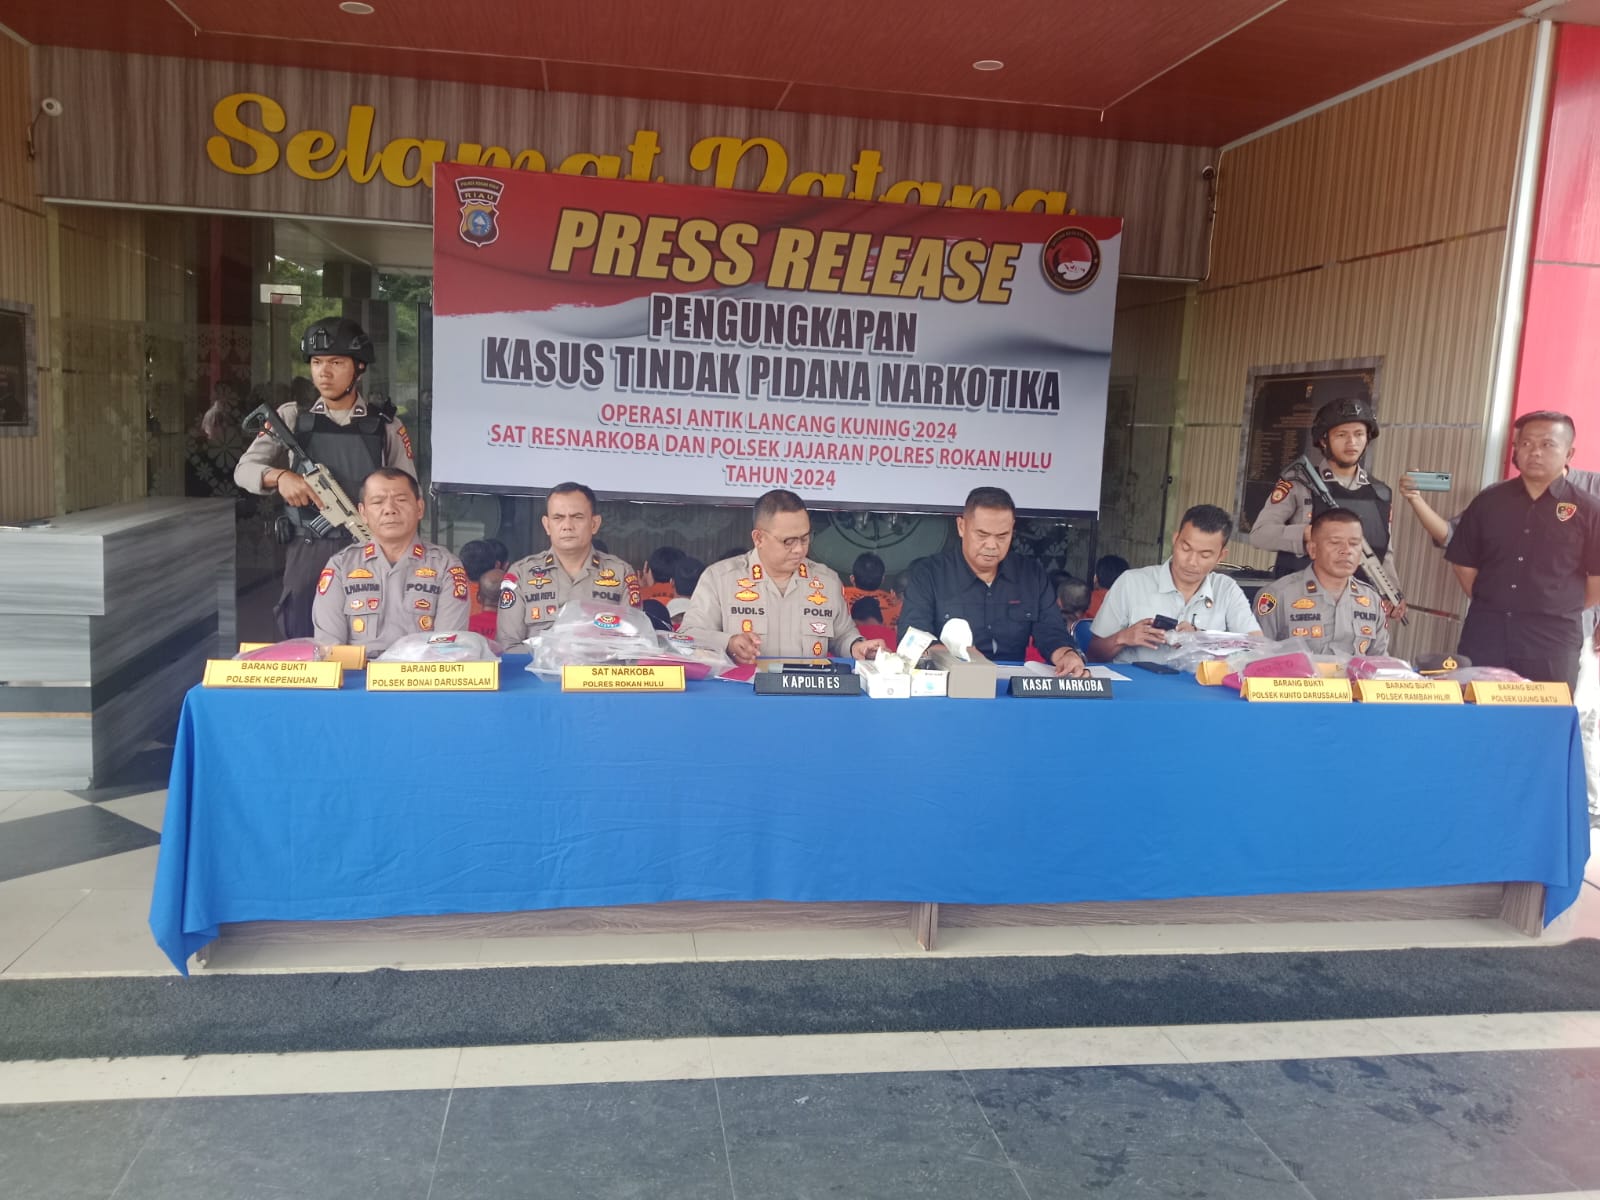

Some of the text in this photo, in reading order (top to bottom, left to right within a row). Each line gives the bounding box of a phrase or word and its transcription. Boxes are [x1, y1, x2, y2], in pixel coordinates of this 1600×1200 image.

[465, 192, 494, 200] RIAU
[549, 207, 1022, 305] PRESS RELEASE
[651, 293, 917, 352] PENGUNGKAPAN
[485, 336, 1061, 411] KASUS TINDAK PIDANA NARKOTIKA
[601, 403, 957, 440] OPERASI ANTIK LANCANG KUNING 2024
[491, 424, 1052, 469] SAT RESNARKOBA DAN POLSEK JAJARAN POLRES ROKAN HULU
[725, 464, 836, 487] TAHUN 2024
[406, 583, 441, 594] POLRI
[592, 591, 621, 602] POLRI
[731, 606, 765, 615] BUDI.S
[803, 607, 833, 617] POLRI
[1354, 611, 1376, 622] POLRI
[241, 662, 307, 671] BARANG BUKTI
[400, 664, 465, 673] BARANG BUKTI
[591, 667, 655, 676] SAT NARKOBA
[226, 675, 318, 684] POLSEK KEPENUHAN
[372, 677, 491, 687] POLSEK BONAI DARUSSALAM
[615, 680, 642, 688] ROKAN
[782, 674, 840, 689] KAPOLRES
[1273, 679, 1324, 687] BARANG BUKTI
[1022, 678, 1104, 693] KASAT NARKOBA
[1498, 683, 1525, 691] BARANG
[1252, 691, 1348, 699] POLSEK KUNTO DARUSSALAM
[1376, 692, 1404, 700] POLSEK
[1405, 693, 1433, 701] RAMBAH
